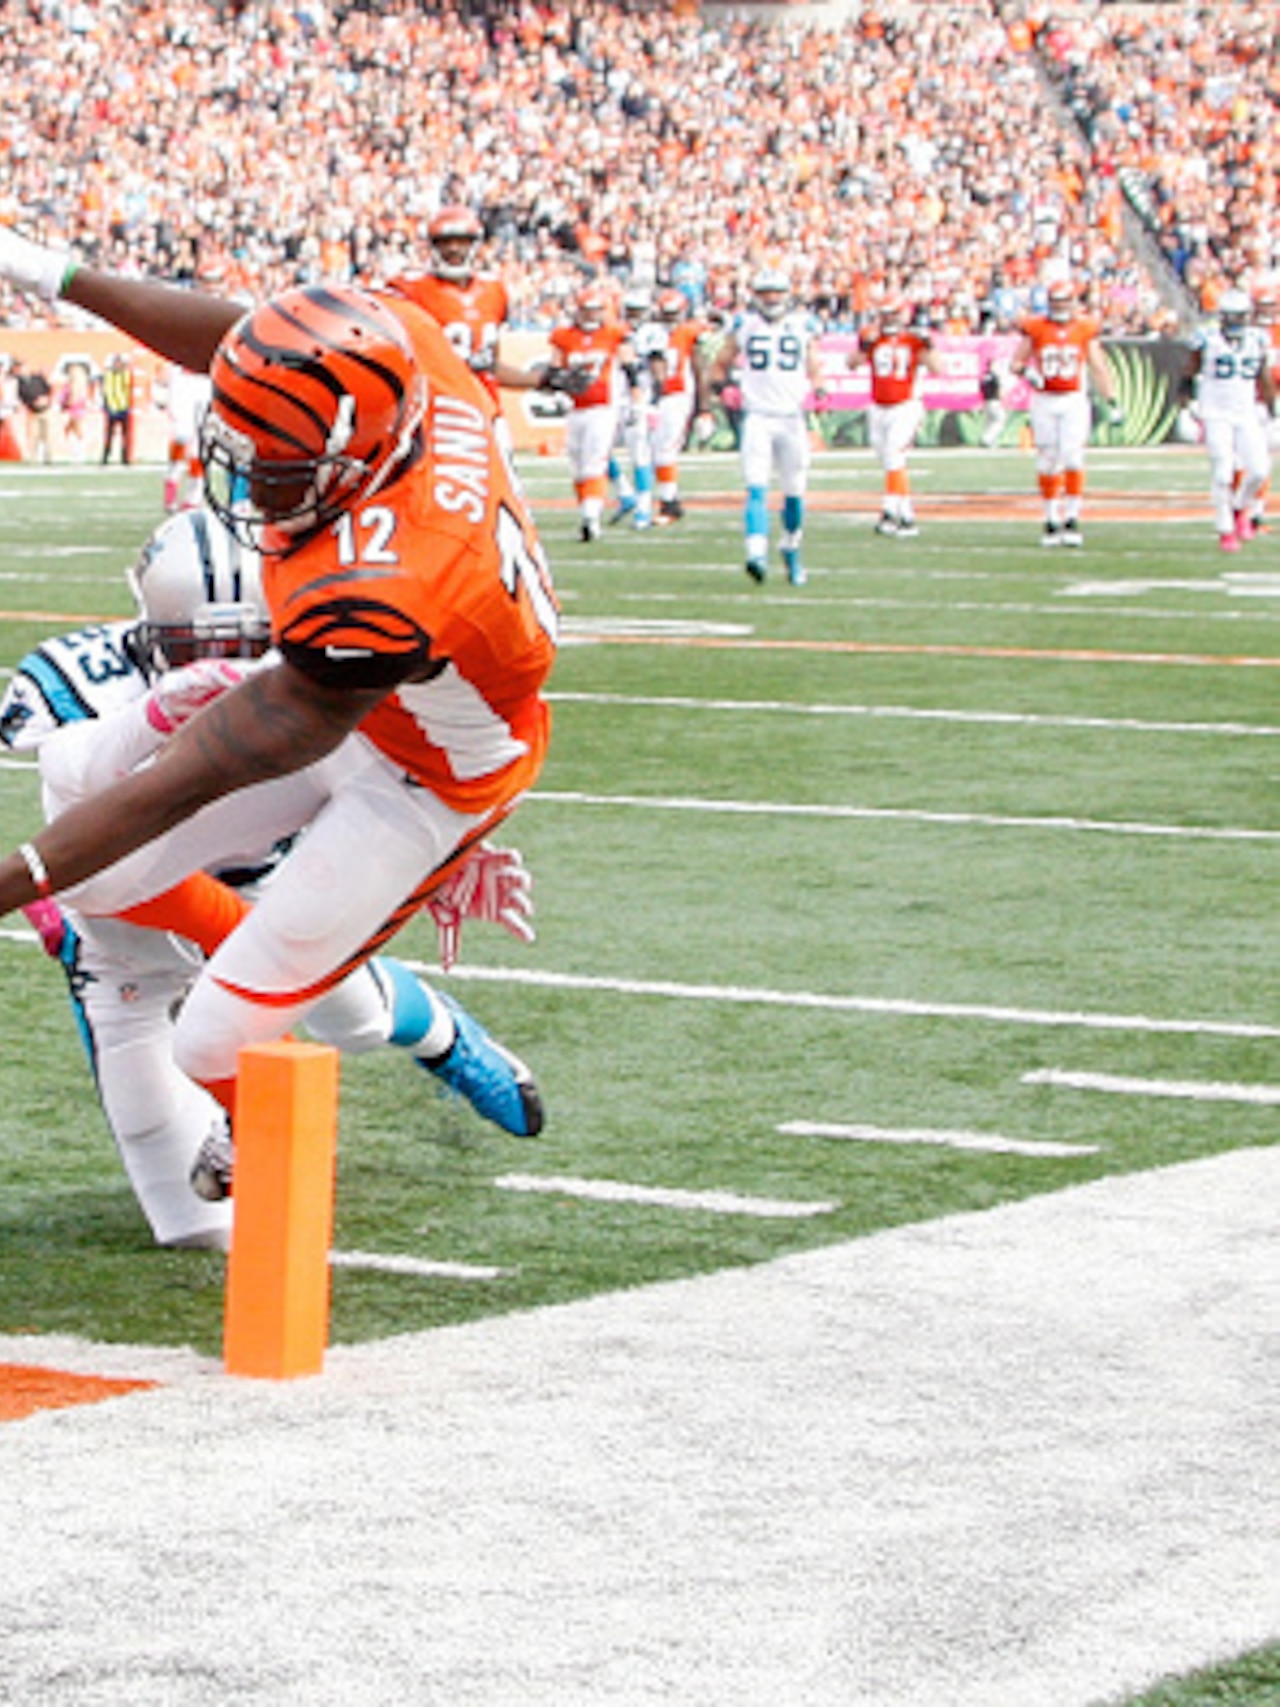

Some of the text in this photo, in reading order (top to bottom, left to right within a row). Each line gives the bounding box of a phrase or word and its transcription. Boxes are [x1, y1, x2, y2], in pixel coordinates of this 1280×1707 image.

[746, 335, 802, 371] 59
[433, 395, 490, 524] SANU
[330, 506, 399, 566] 12
